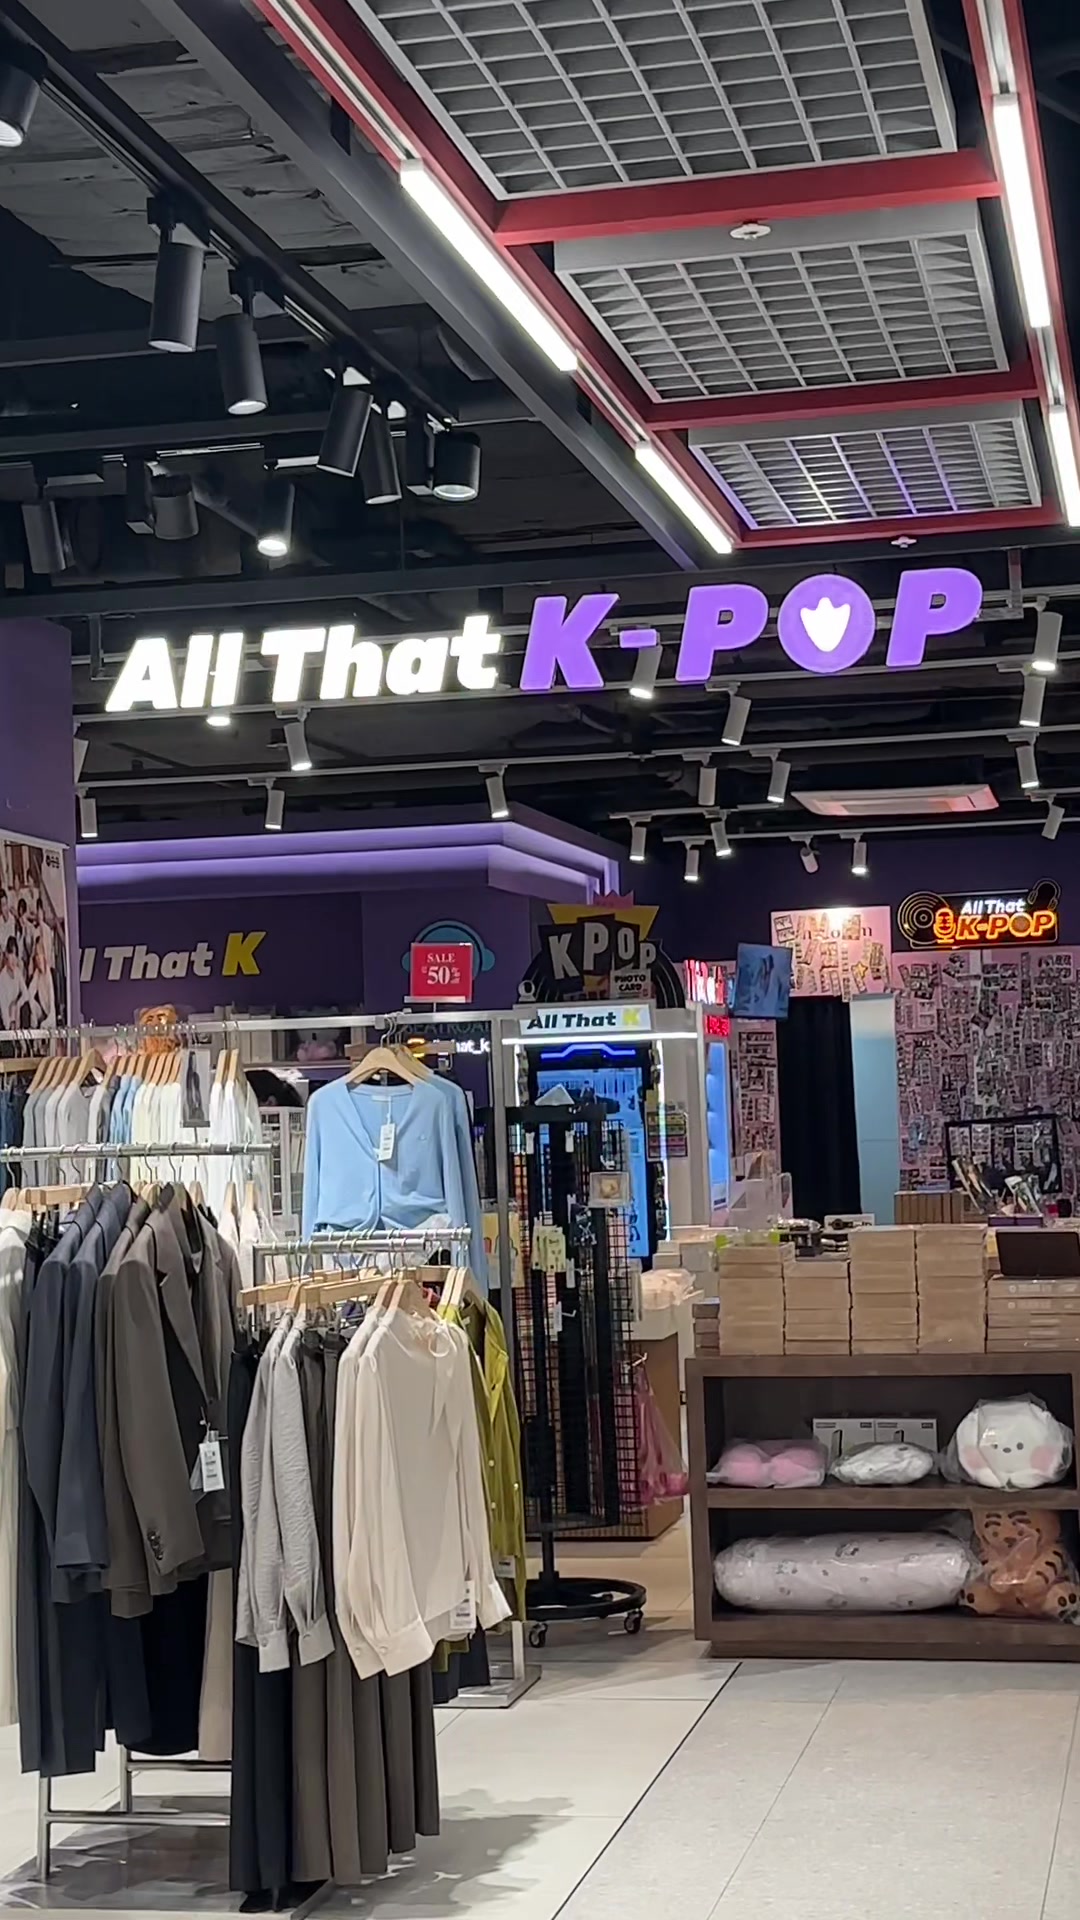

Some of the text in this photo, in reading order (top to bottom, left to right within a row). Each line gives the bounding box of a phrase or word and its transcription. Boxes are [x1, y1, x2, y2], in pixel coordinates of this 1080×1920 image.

[105, 567, 983, 712] All That K-POP
[961, 898, 1026, 915] All That
[955, 910, 1056, 940] K-POP
[104, 942, 214, 981] That
[222, 931, 267, 976] K
[427, 953, 456, 963] SALE
[548, 922, 656, 979] KPOP
[615, 974, 646, 983] PHOTO
[619, 983, 642, 991] CARD
[527, 1008, 641, 1029] All That K
